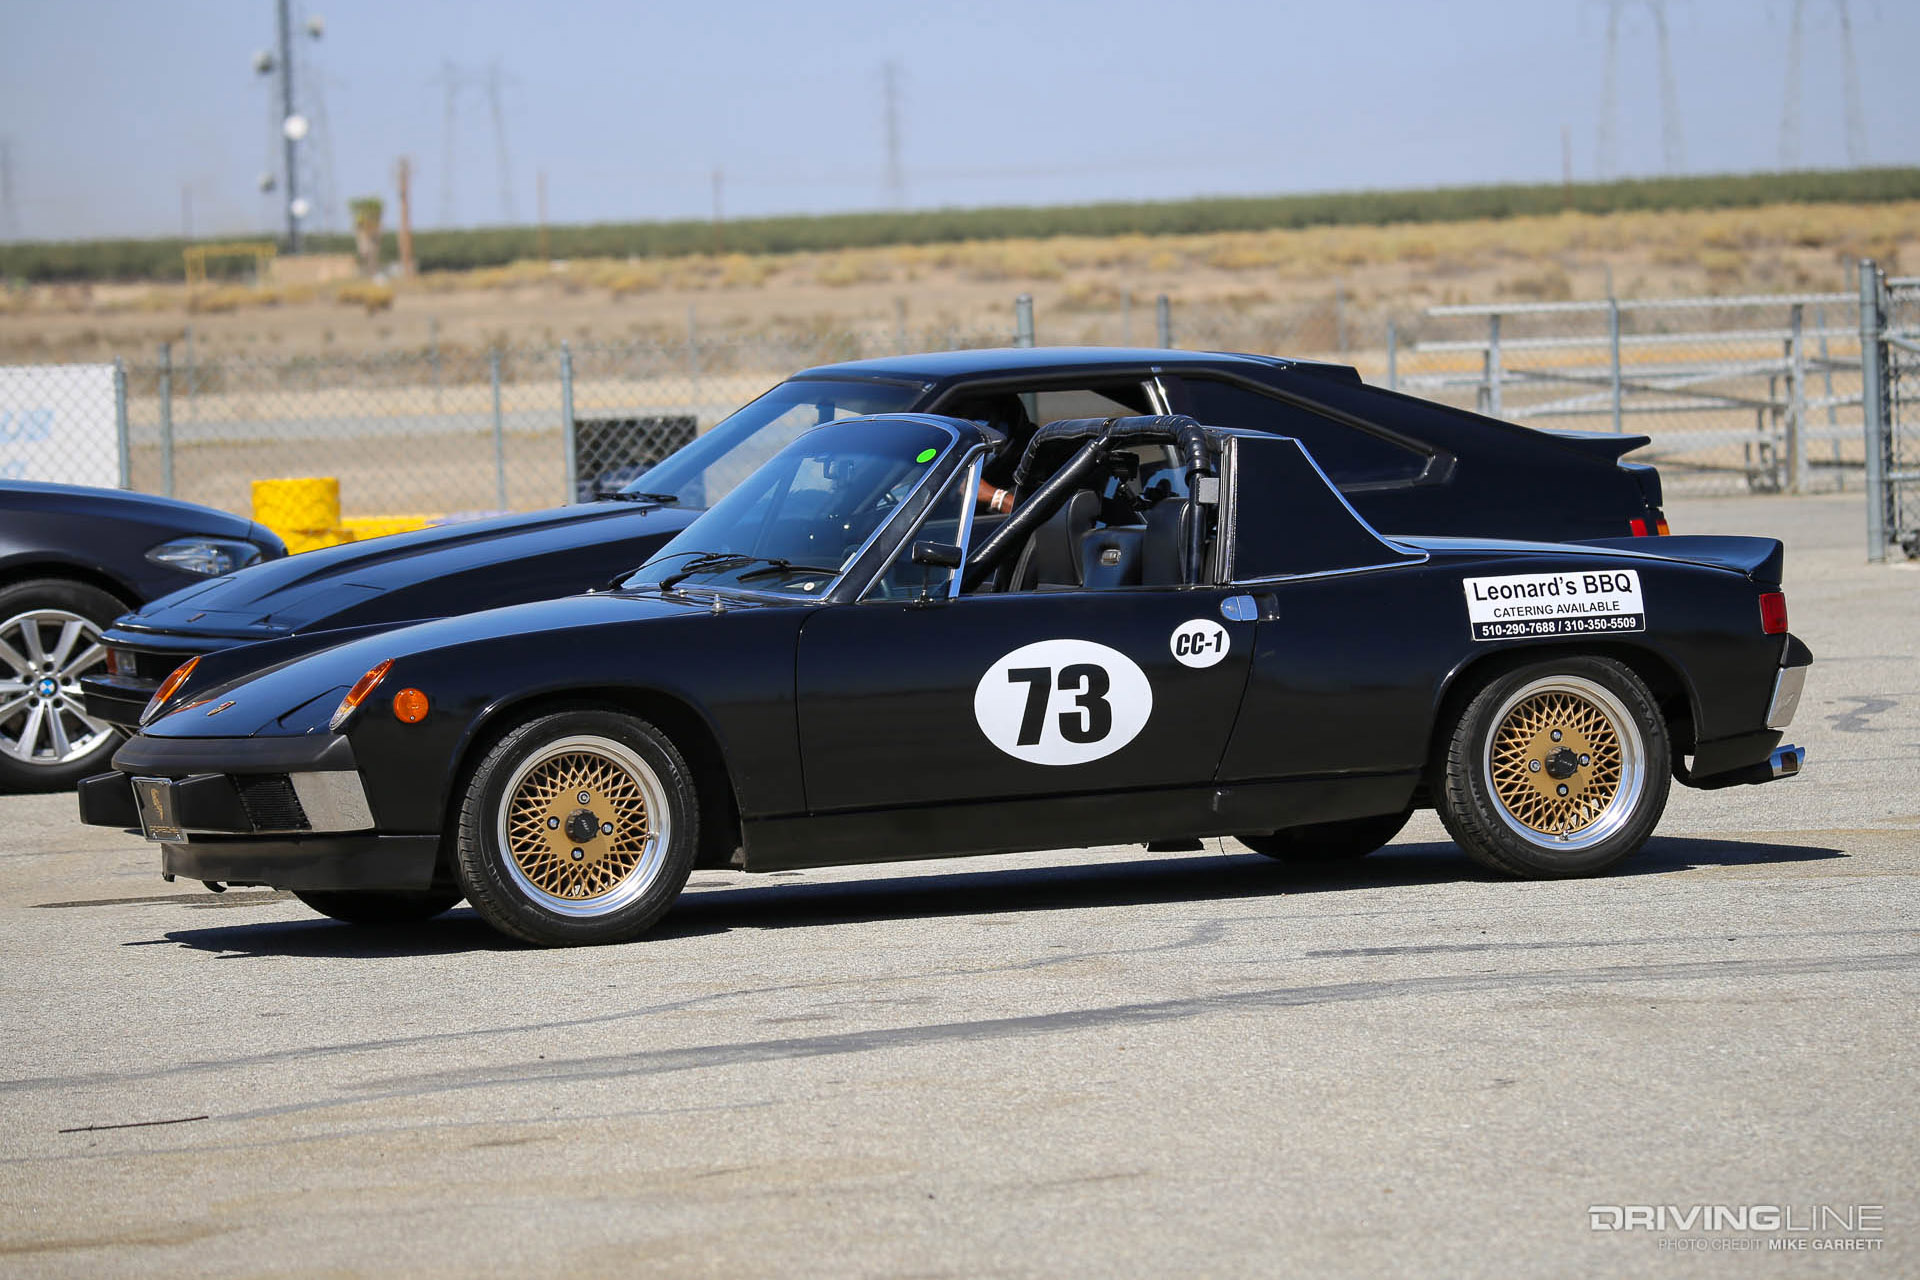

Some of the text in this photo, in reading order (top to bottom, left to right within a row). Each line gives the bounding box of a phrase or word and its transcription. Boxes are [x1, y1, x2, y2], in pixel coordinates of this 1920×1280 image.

[1473, 573, 1632, 601] Leonard's BBQ
[1493, 601, 1620, 618] CATERING AVAILABLE
[1482, 622, 1556, 636] 510-290-7688
[1564, 617, 1636, 631] 310-350-5509
[1175, 630, 1223, 657] CC-1
[1008, 663, 1112, 746] 73
